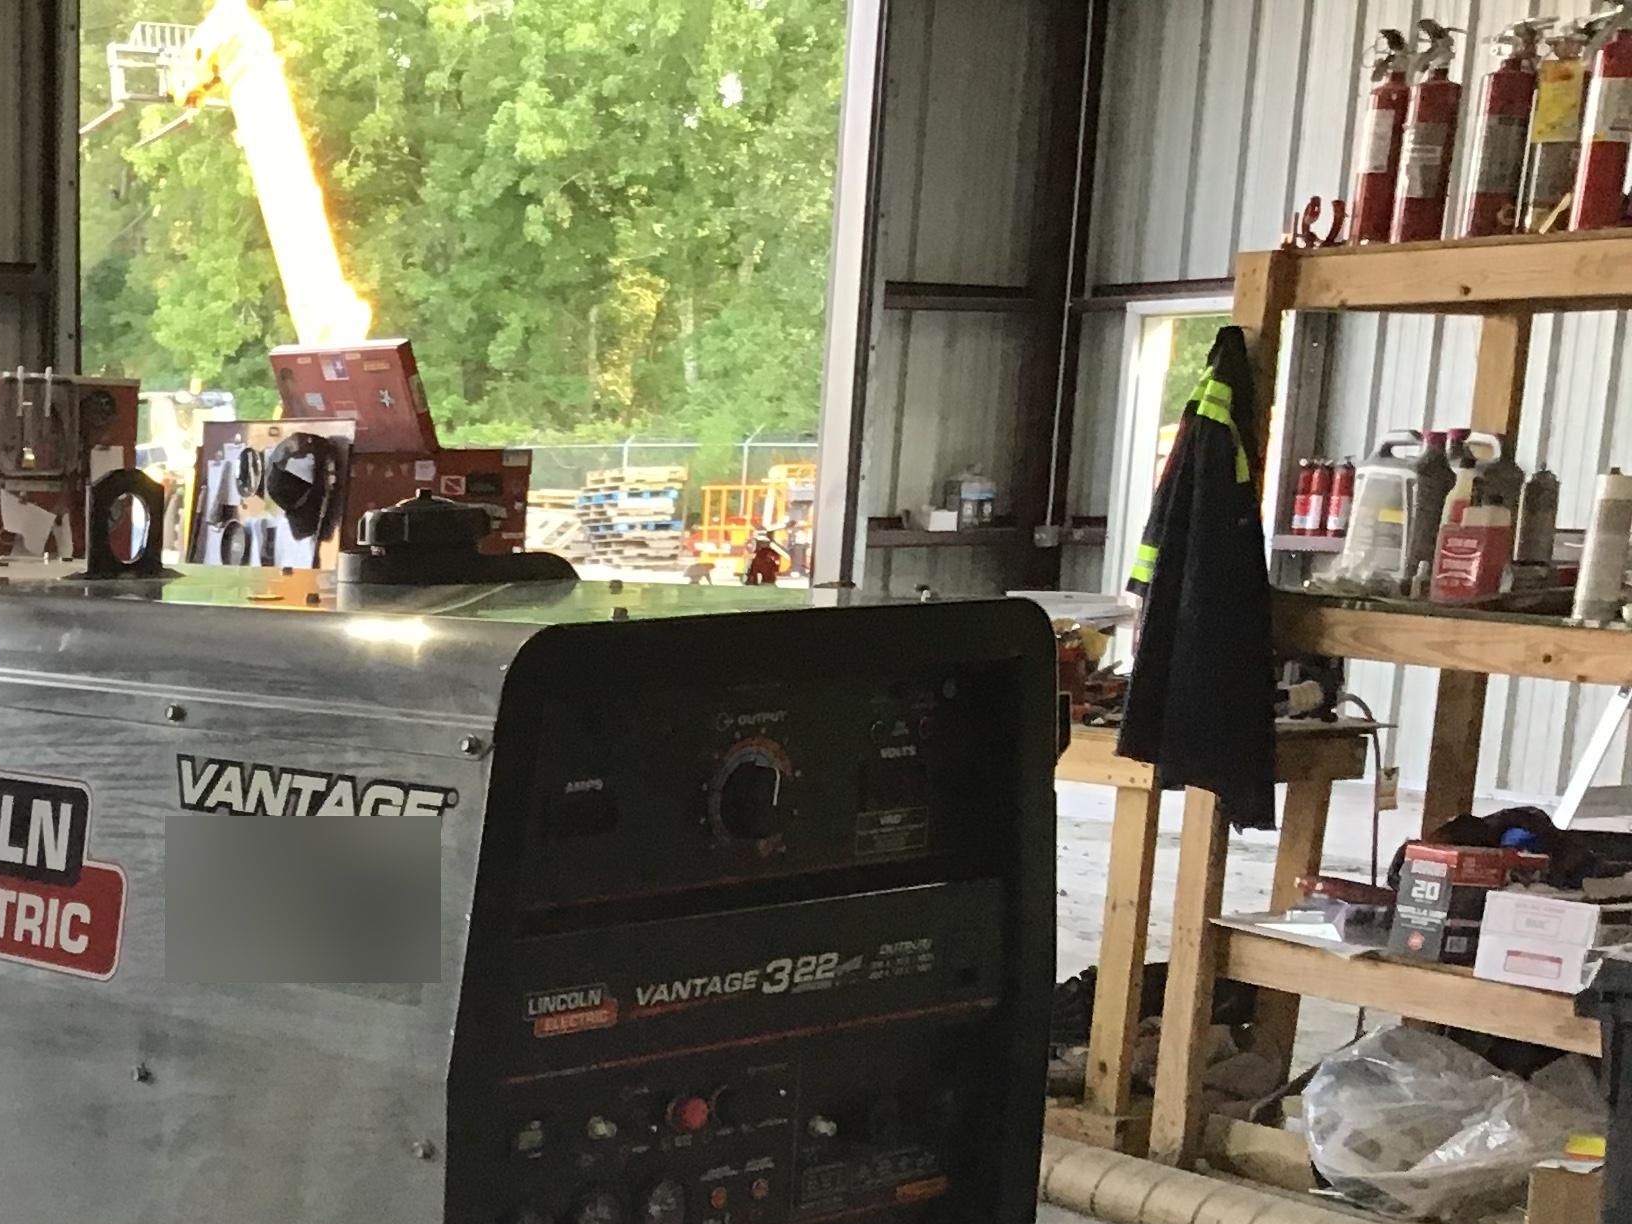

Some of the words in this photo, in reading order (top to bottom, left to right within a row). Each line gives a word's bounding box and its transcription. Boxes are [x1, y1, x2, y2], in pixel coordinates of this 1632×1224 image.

[737, 709, 788, 727] OUTPUT
[879, 743, 917, 760] VOLTS
[179, 757, 447, 817] VANTAGE
[635, 967, 761, 1007] VANTAGE
[760, 951, 841, 995] 322
[527, 988, 604, 1017] LINCOLN
[540, 1007, 611, 1033] ELECTRIC
